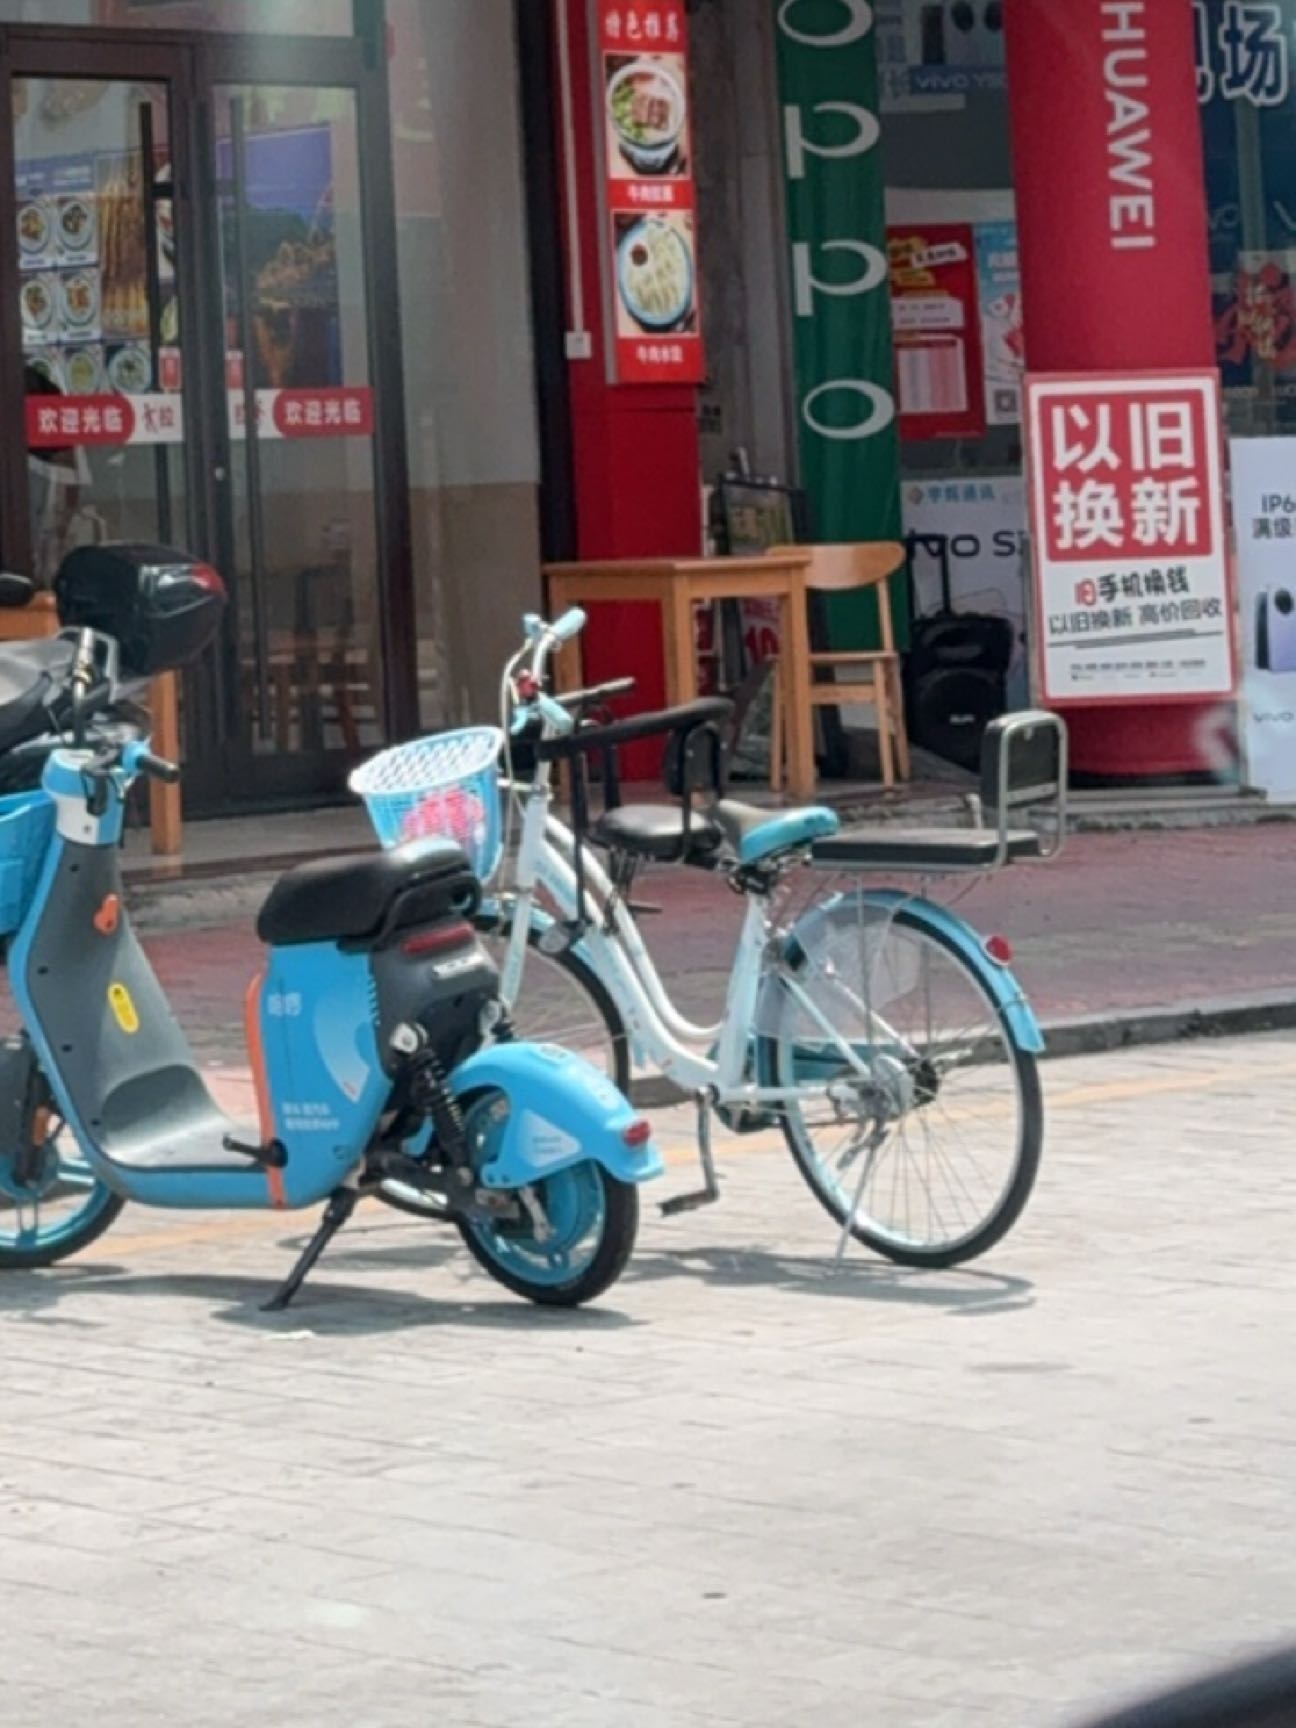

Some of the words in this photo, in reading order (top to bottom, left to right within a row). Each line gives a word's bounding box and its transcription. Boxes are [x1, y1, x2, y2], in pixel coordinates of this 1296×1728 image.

[1100, 0, 1156, 250] HUAWEI
[38, 406, 123, 434] 欢迎光临
[284, 398, 362, 426] 欢迎光临
[1049, 400, 1196, 472] 以旧
[1051, 476, 1202, 550] 换新
[1048, 605, 1133, 635] 以旧换新
[1138, 596, 1222, 625] 高价回收
